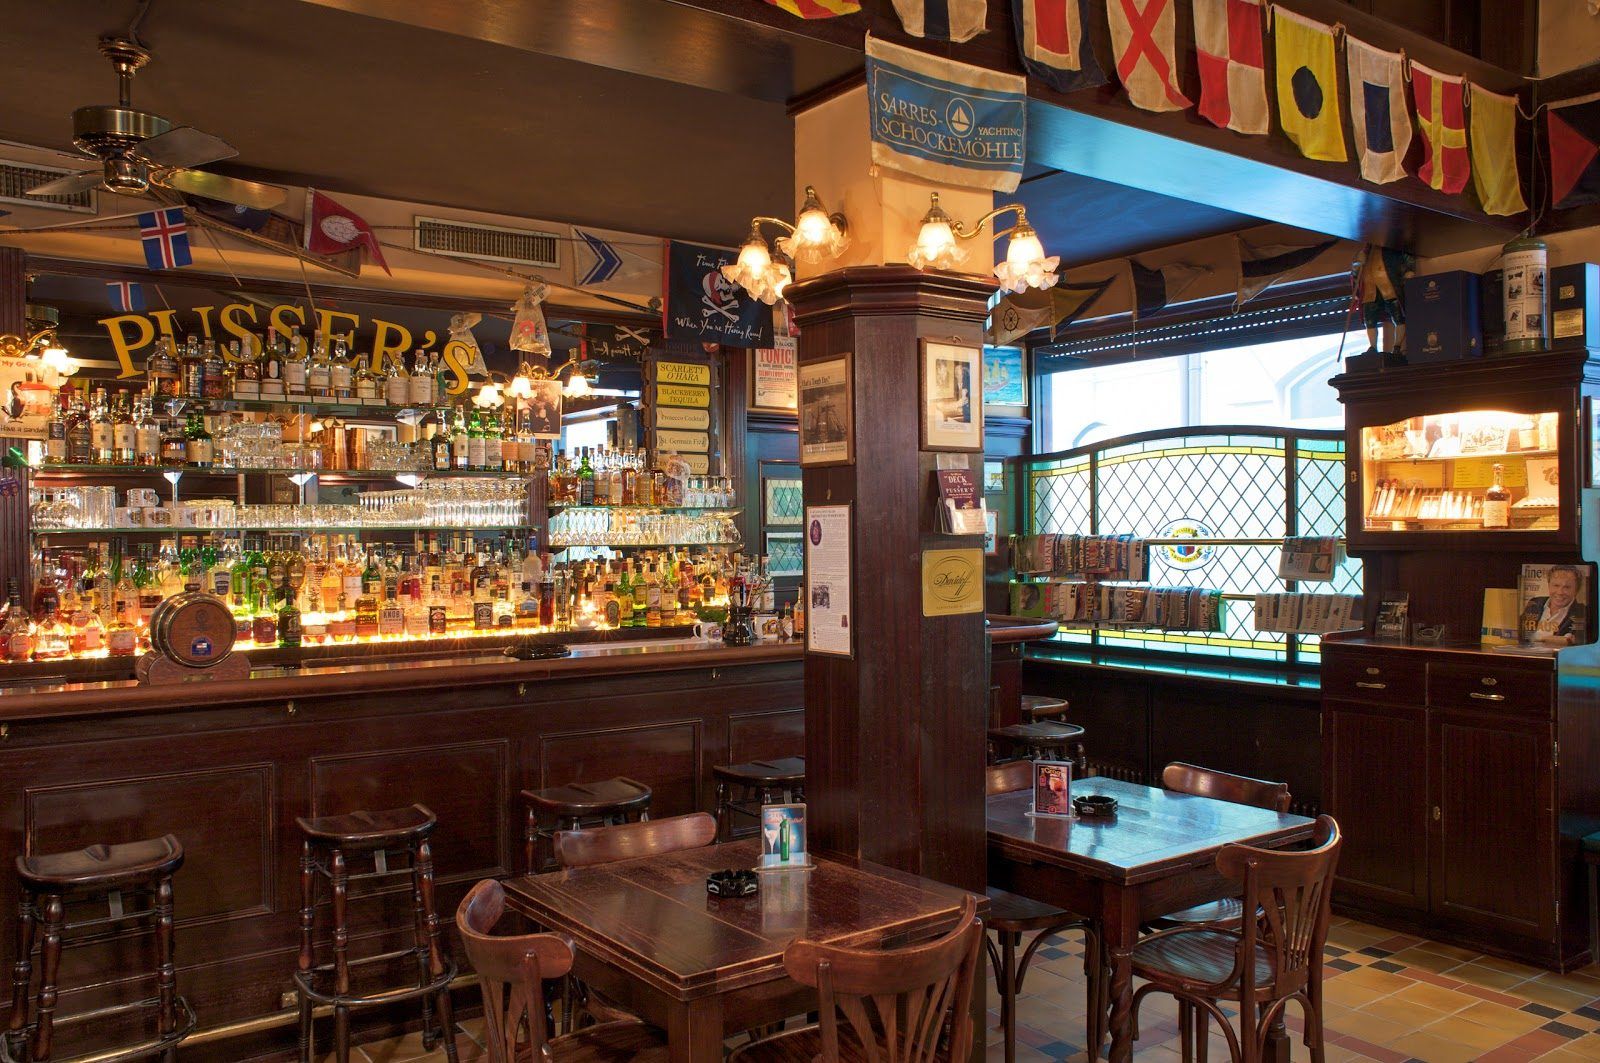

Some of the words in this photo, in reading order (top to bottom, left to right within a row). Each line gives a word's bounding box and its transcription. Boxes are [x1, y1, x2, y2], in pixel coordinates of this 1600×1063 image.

[880, 93, 943, 127] SARRES-
[881, 116, 1022, 159] SCHOCKEMÖHLE
[978, 126, 1022, 137] YACHTING
[696, 253, 716, 269] Time
[674, 316, 698, 329] When
[699, 317, 723, 336] You're
[97, 303, 477, 396] PUSSER'S
[660, 363, 706, 375] SCARLETT
[666, 371, 700, 382] O'HARA
[661, 388, 706, 397] BLACKBERRY
[669, 396, 699, 405] TEQUILA
